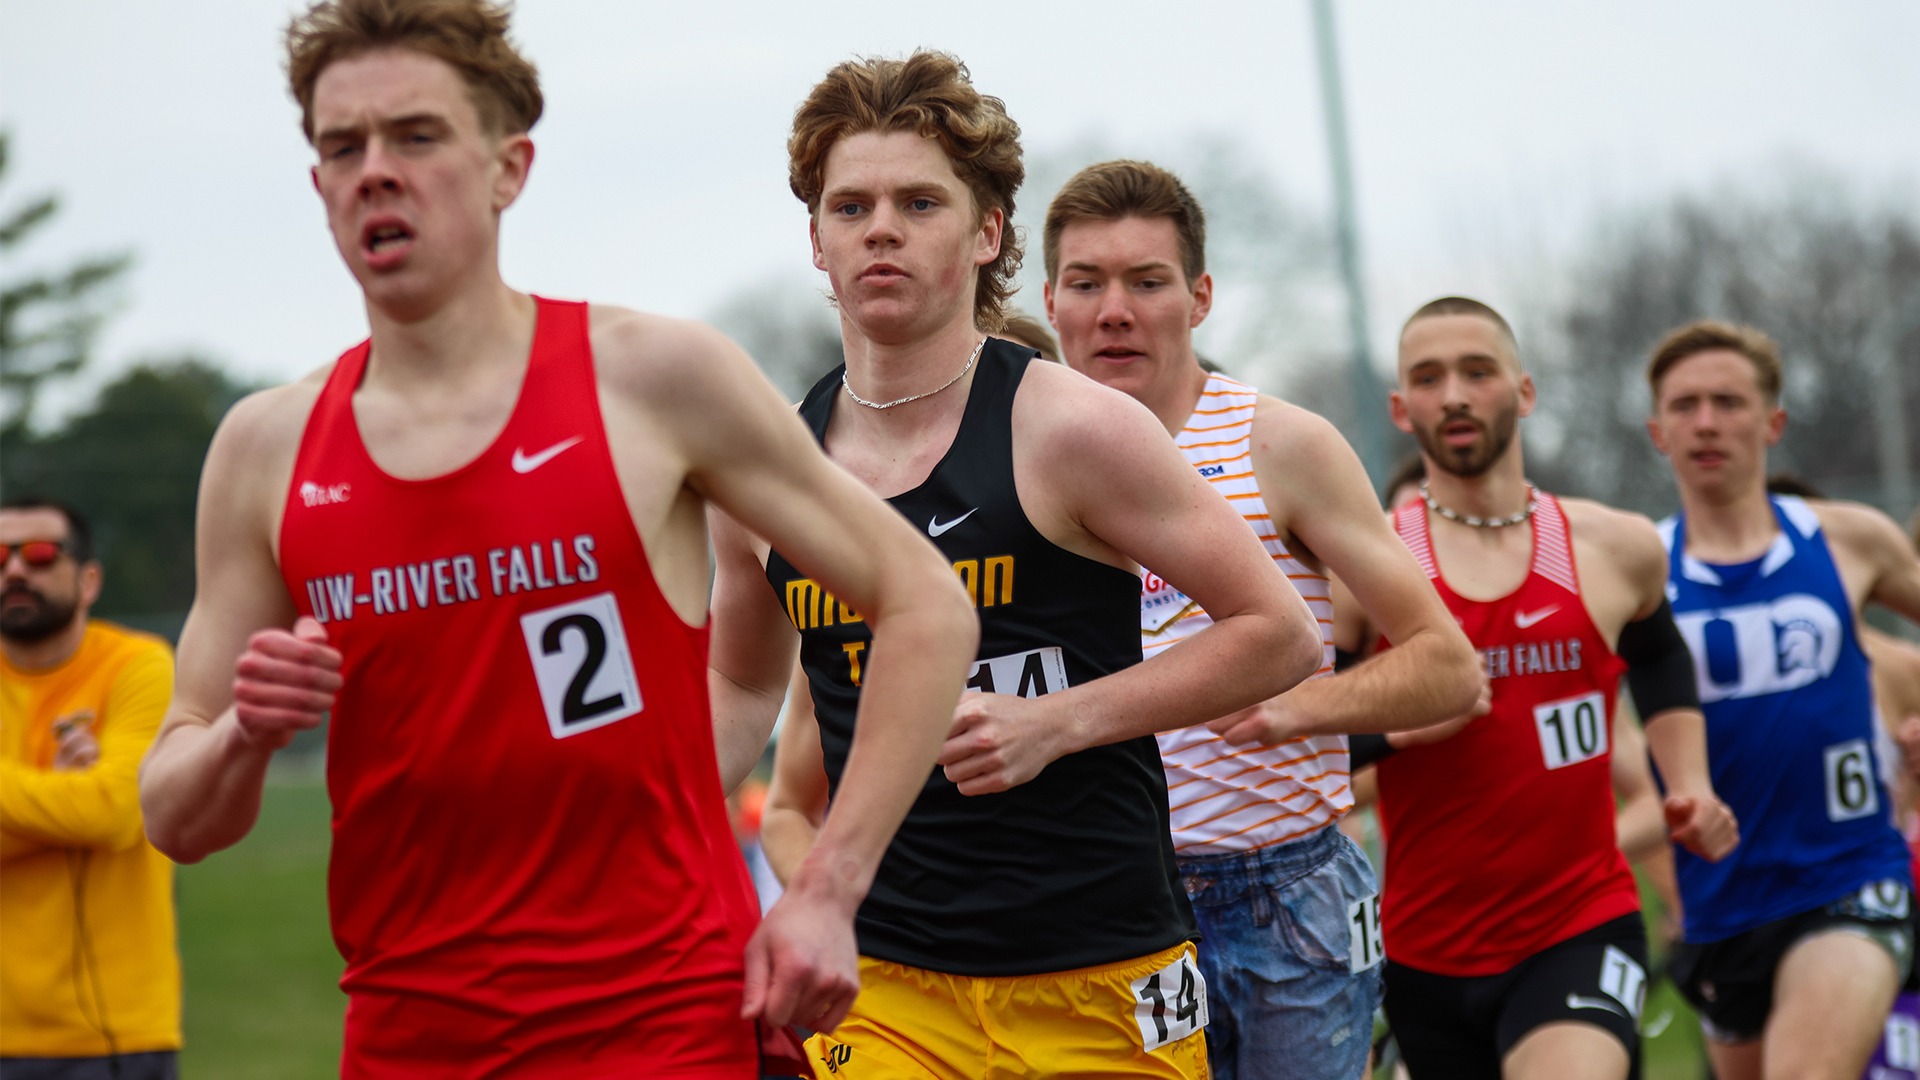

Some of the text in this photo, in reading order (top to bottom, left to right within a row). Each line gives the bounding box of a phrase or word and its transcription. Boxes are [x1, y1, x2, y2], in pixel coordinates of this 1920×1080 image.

[306, 534, 600, 623] UW-RIVER FALLS
[541, 613, 625, 727] 2
[1513, 636, 1583, 676] FALLS
[1543, 701, 1597, 763] 10
[1835, 751, 1868, 809] 6
[1140, 960, 1198, 1043] 14
